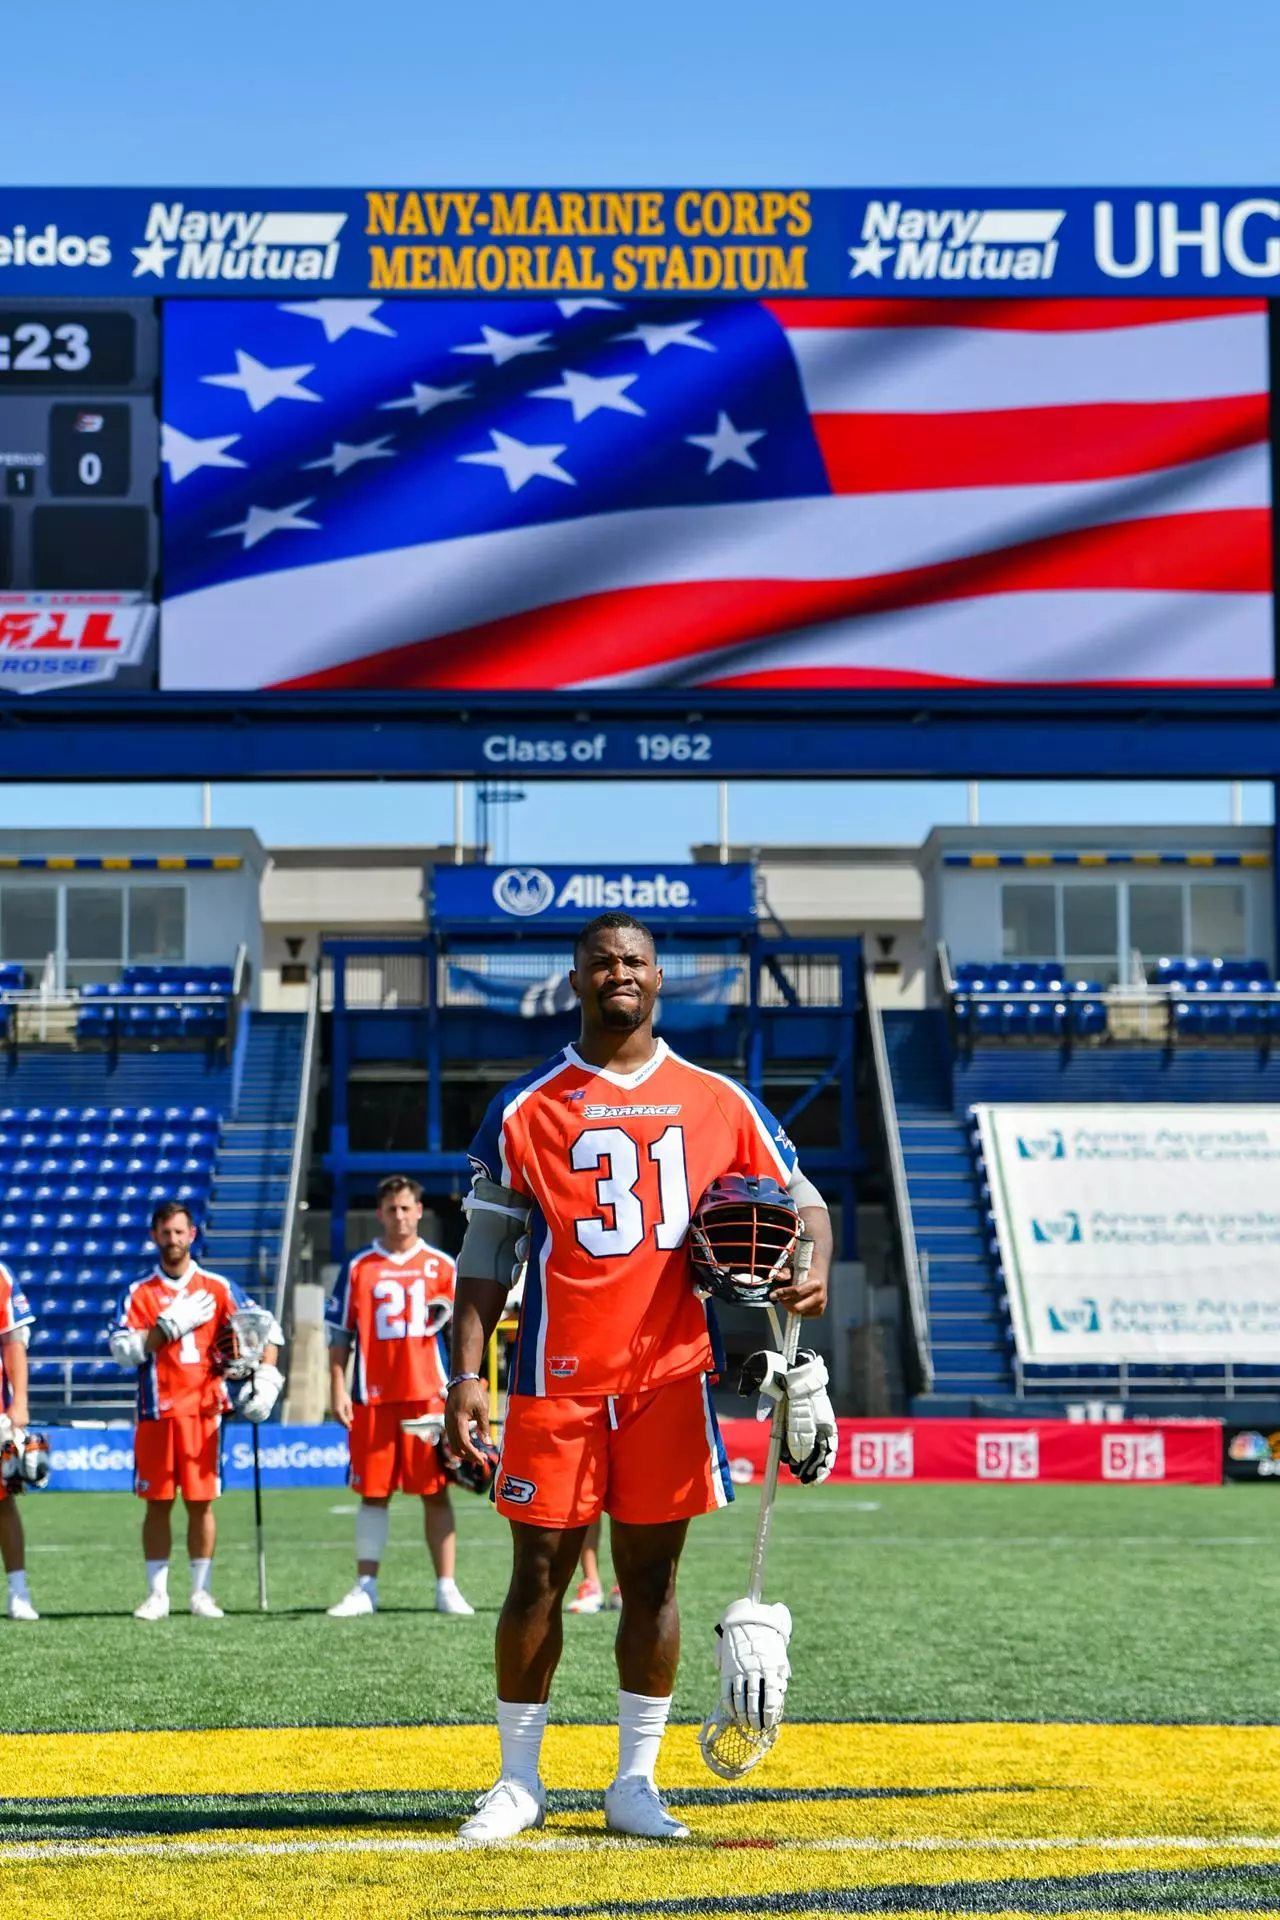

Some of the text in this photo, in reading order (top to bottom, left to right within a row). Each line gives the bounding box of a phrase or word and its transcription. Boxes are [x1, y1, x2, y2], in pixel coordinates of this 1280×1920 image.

[145, 203, 263, 248] Navy
[365, 190, 812, 237] NAVY-MARINE CORPS
[861, 201, 981, 248] Navy
[177, 242, 340, 280] Mutual
[893, 240, 1058, 280] Mutual
[1093, 198, 1280, 279] UHG
[368, 245, 808, 291] MEMORIAL STADIUM
[78, 452, 103, 486] 0
[483, 733, 713, 763] Class of 1962
[555, 873, 691, 909] Allstate
[569, 1124, 692, 1259] 31
[424, 1257, 440, 1279] C
[373, 1278, 426, 1340] 21
